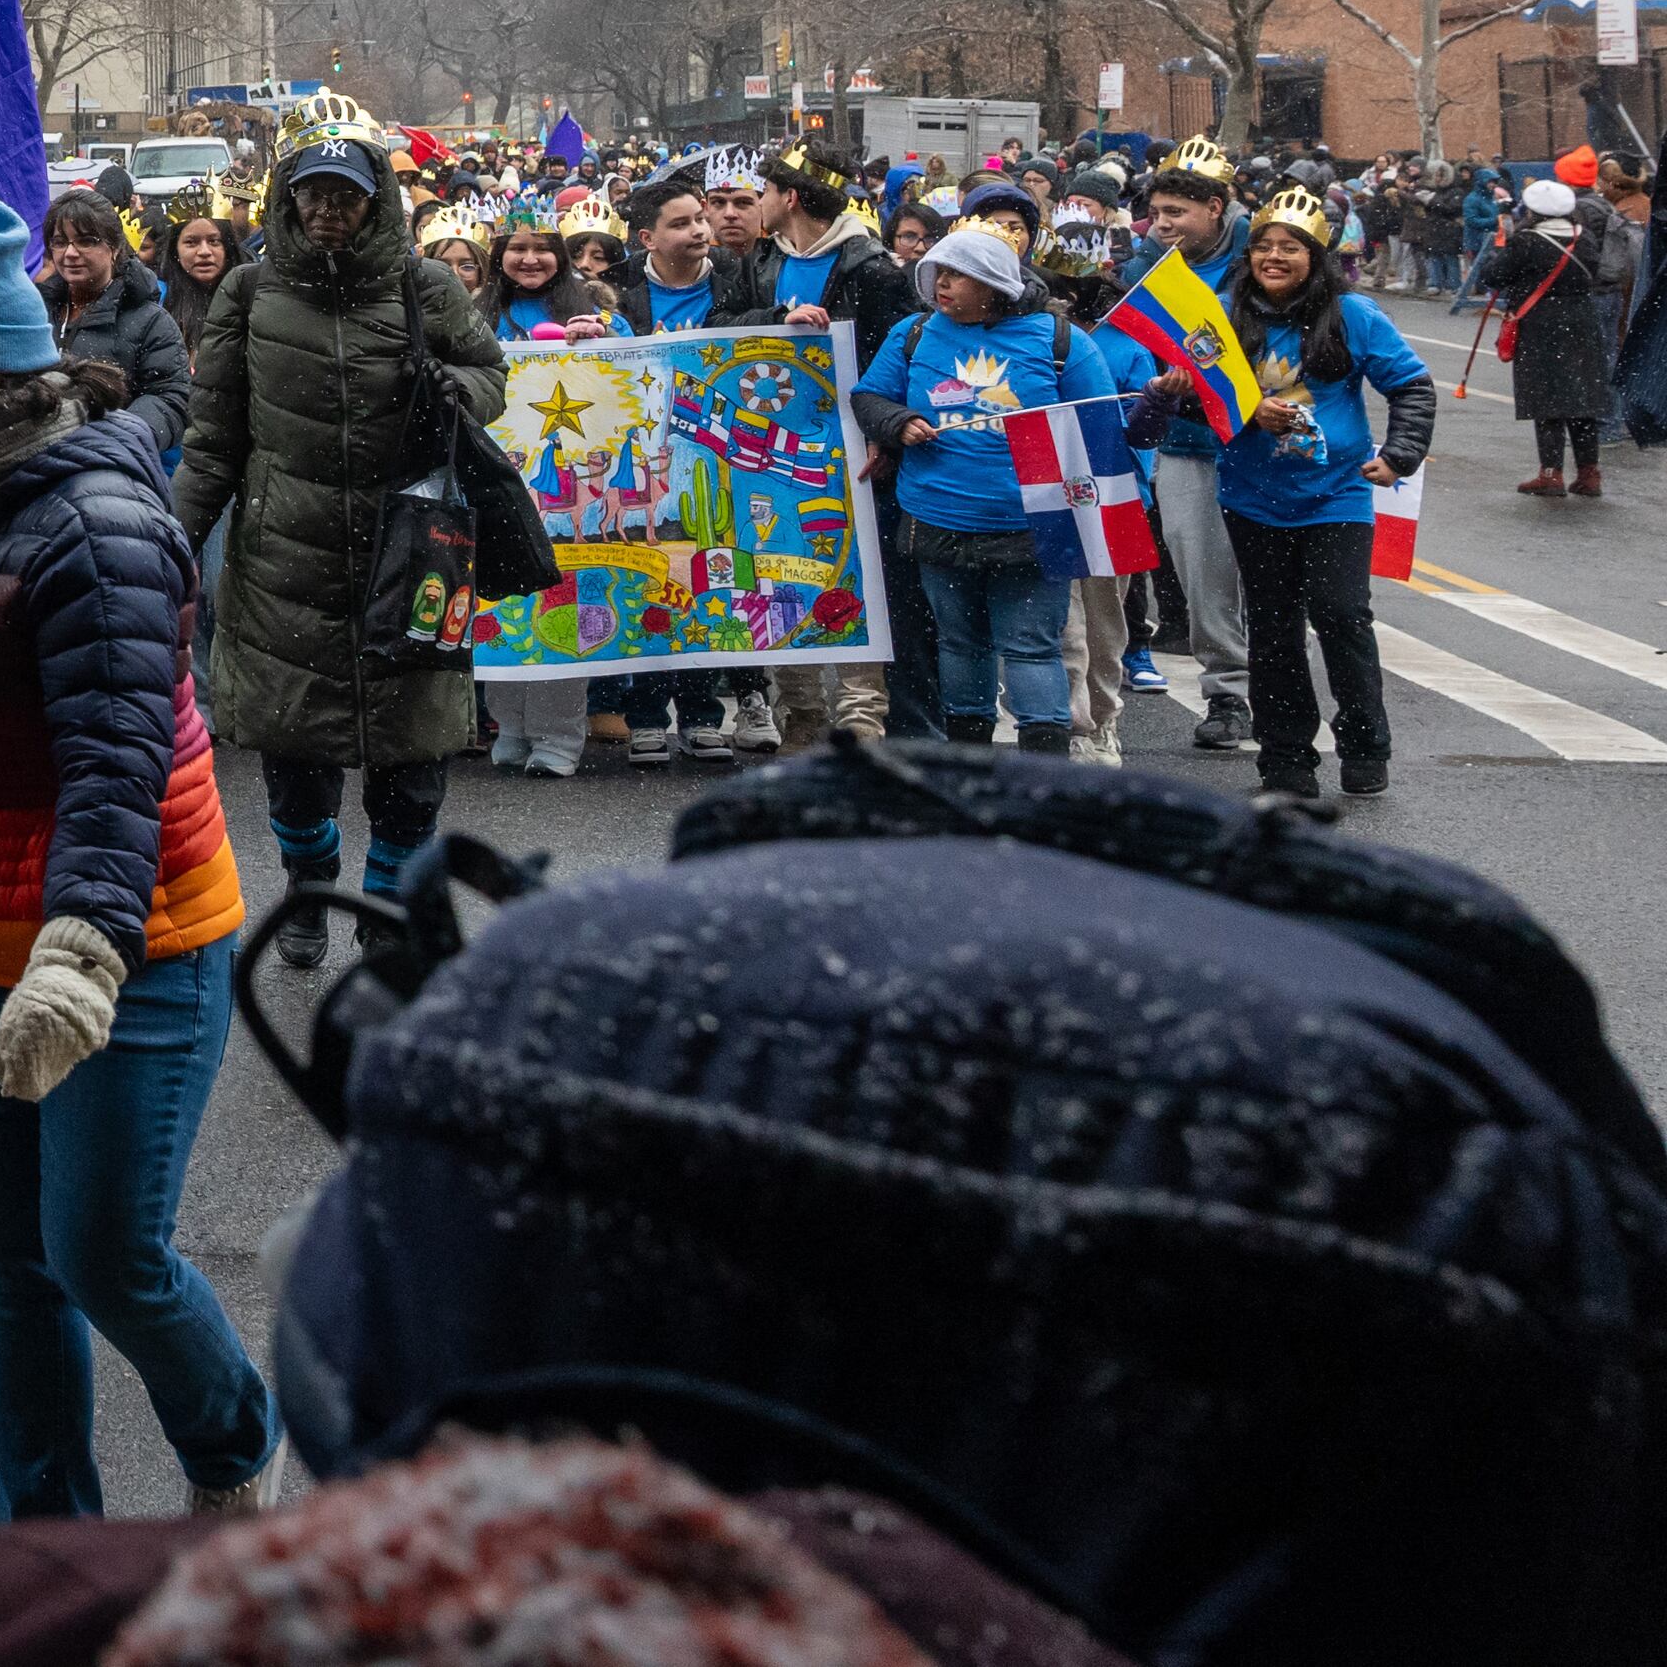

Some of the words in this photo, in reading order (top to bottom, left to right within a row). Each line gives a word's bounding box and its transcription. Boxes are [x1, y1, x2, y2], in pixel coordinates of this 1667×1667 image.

[513, 352, 559, 365] UNITED
[571, 349, 642, 363] CELEBRATE
[645, 345, 698, 359] TRADITIONS
[798, 558, 817, 568] los
